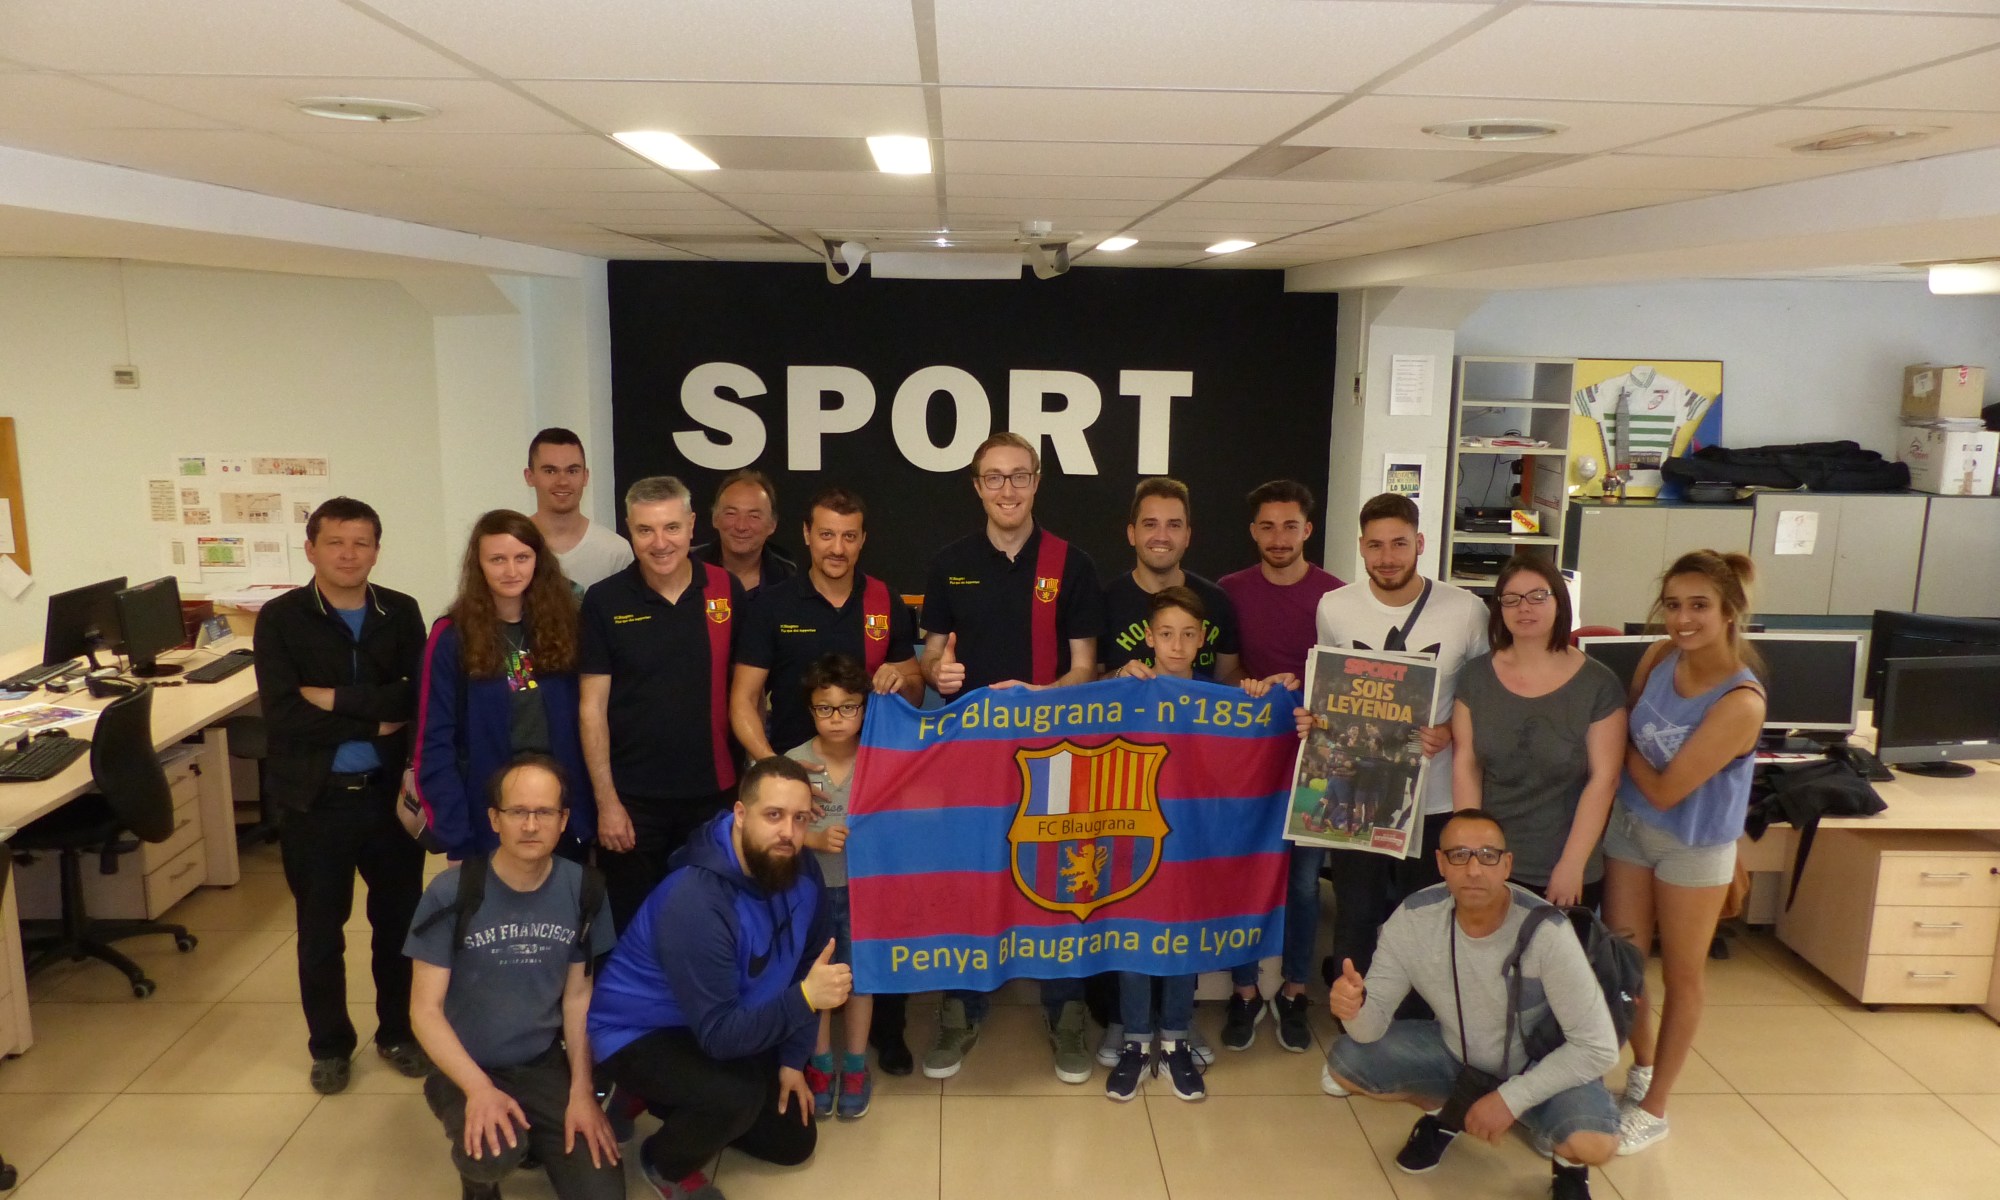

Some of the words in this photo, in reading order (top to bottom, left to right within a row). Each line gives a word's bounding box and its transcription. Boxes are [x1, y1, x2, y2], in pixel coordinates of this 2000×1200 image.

[672, 362, 1194, 475] SPORT
[1513, 511, 1535, 529] SPORT
[1344, 658, 1408, 681] SPORT
[1351, 679, 1395, 701] SOIS
[919, 714, 956, 739] FC
[962, 697, 1122, 733] Blaugrana
[1157, 695, 1272, 727] n°1854
[1327, 694, 1413, 724] LEYENDA
[1038, 821, 1057, 835] FC
[1062, 819, 1135, 835] Blaugrana
[464, 928, 496, 949] SAN
[500, 923, 576, 944] FRANCISCO
[892, 945, 988, 973] Penya
[999, 931, 1140, 963] Blaugrana
[1151, 928, 1190, 955] de
[1200, 927, 1262, 957] Lyon
